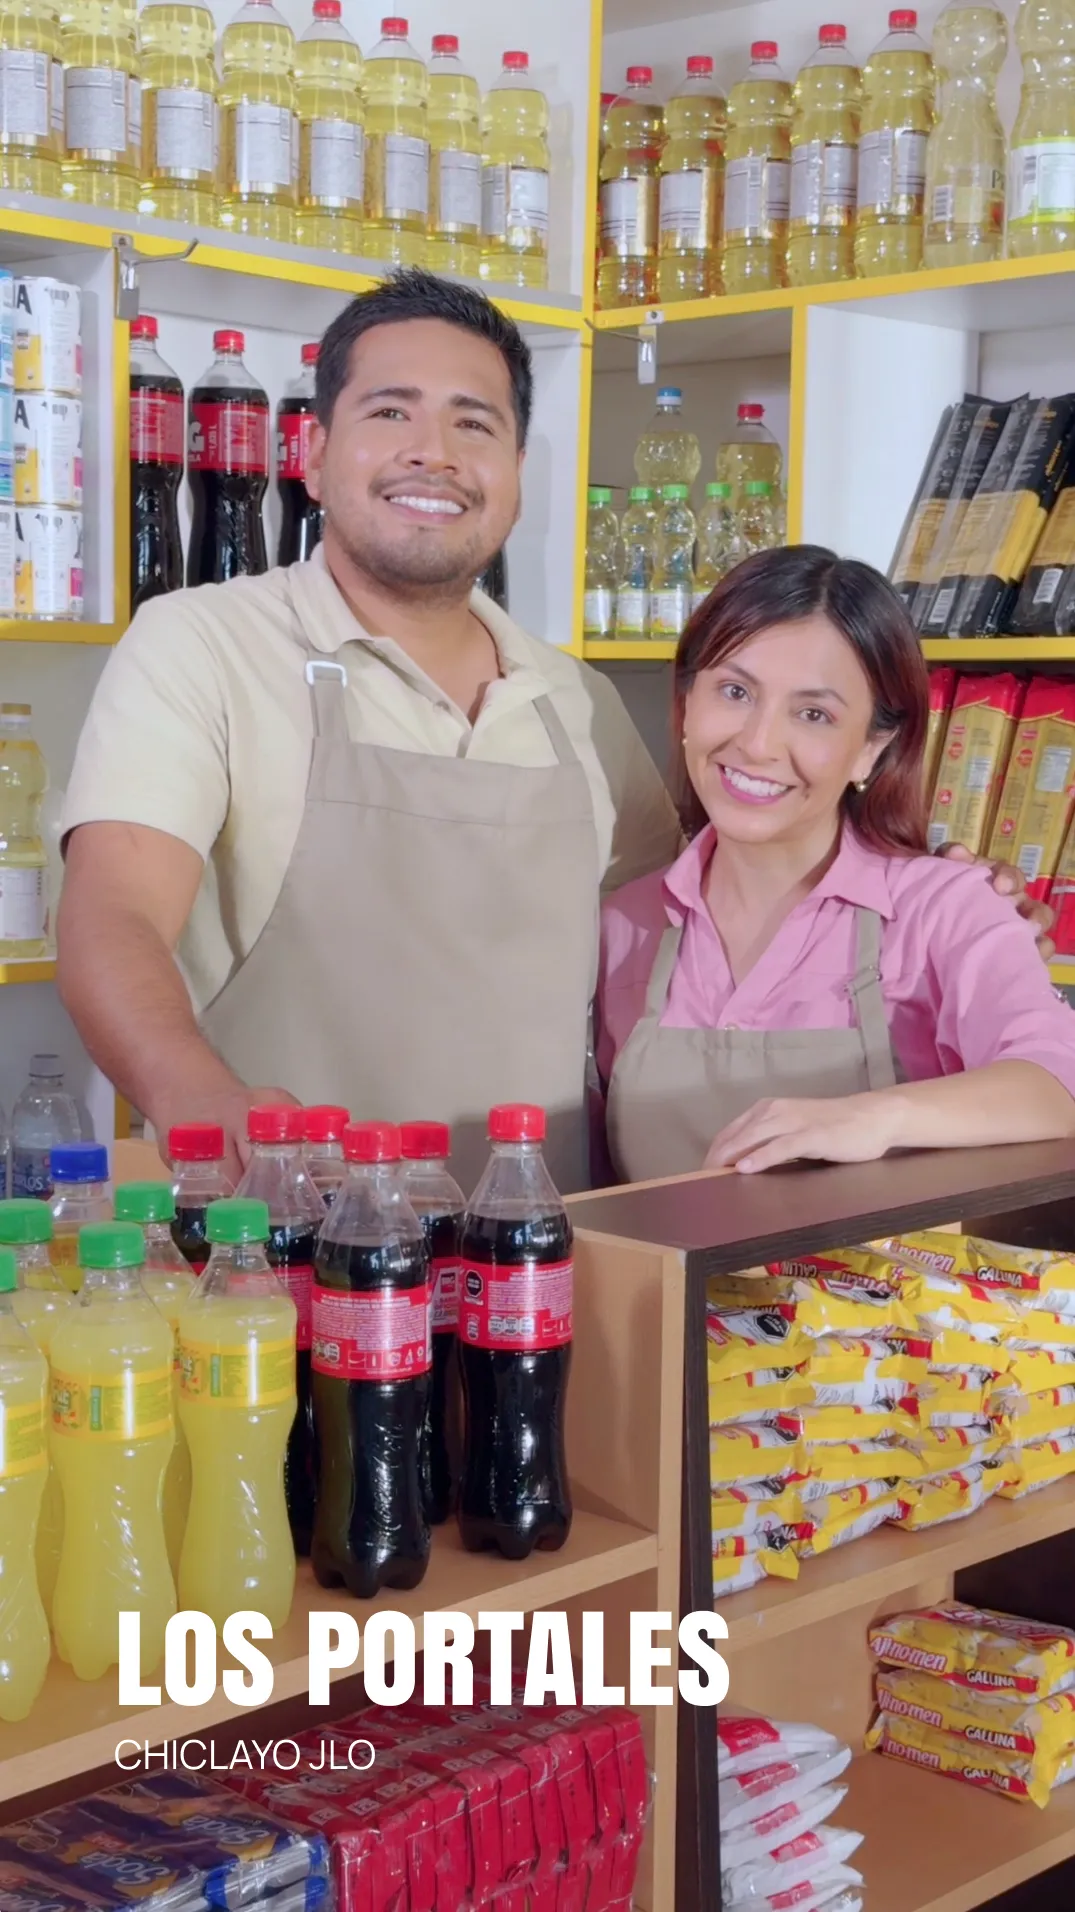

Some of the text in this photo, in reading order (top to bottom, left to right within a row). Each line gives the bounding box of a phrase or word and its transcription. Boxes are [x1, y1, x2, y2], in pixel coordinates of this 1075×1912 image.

[966, 1669, 1016, 1688] GALLINA
[965, 1726, 1017, 1750] GALLINA
[181, 1814, 270, 1845] Soda
[80, 1851, 171, 1886] Soda
